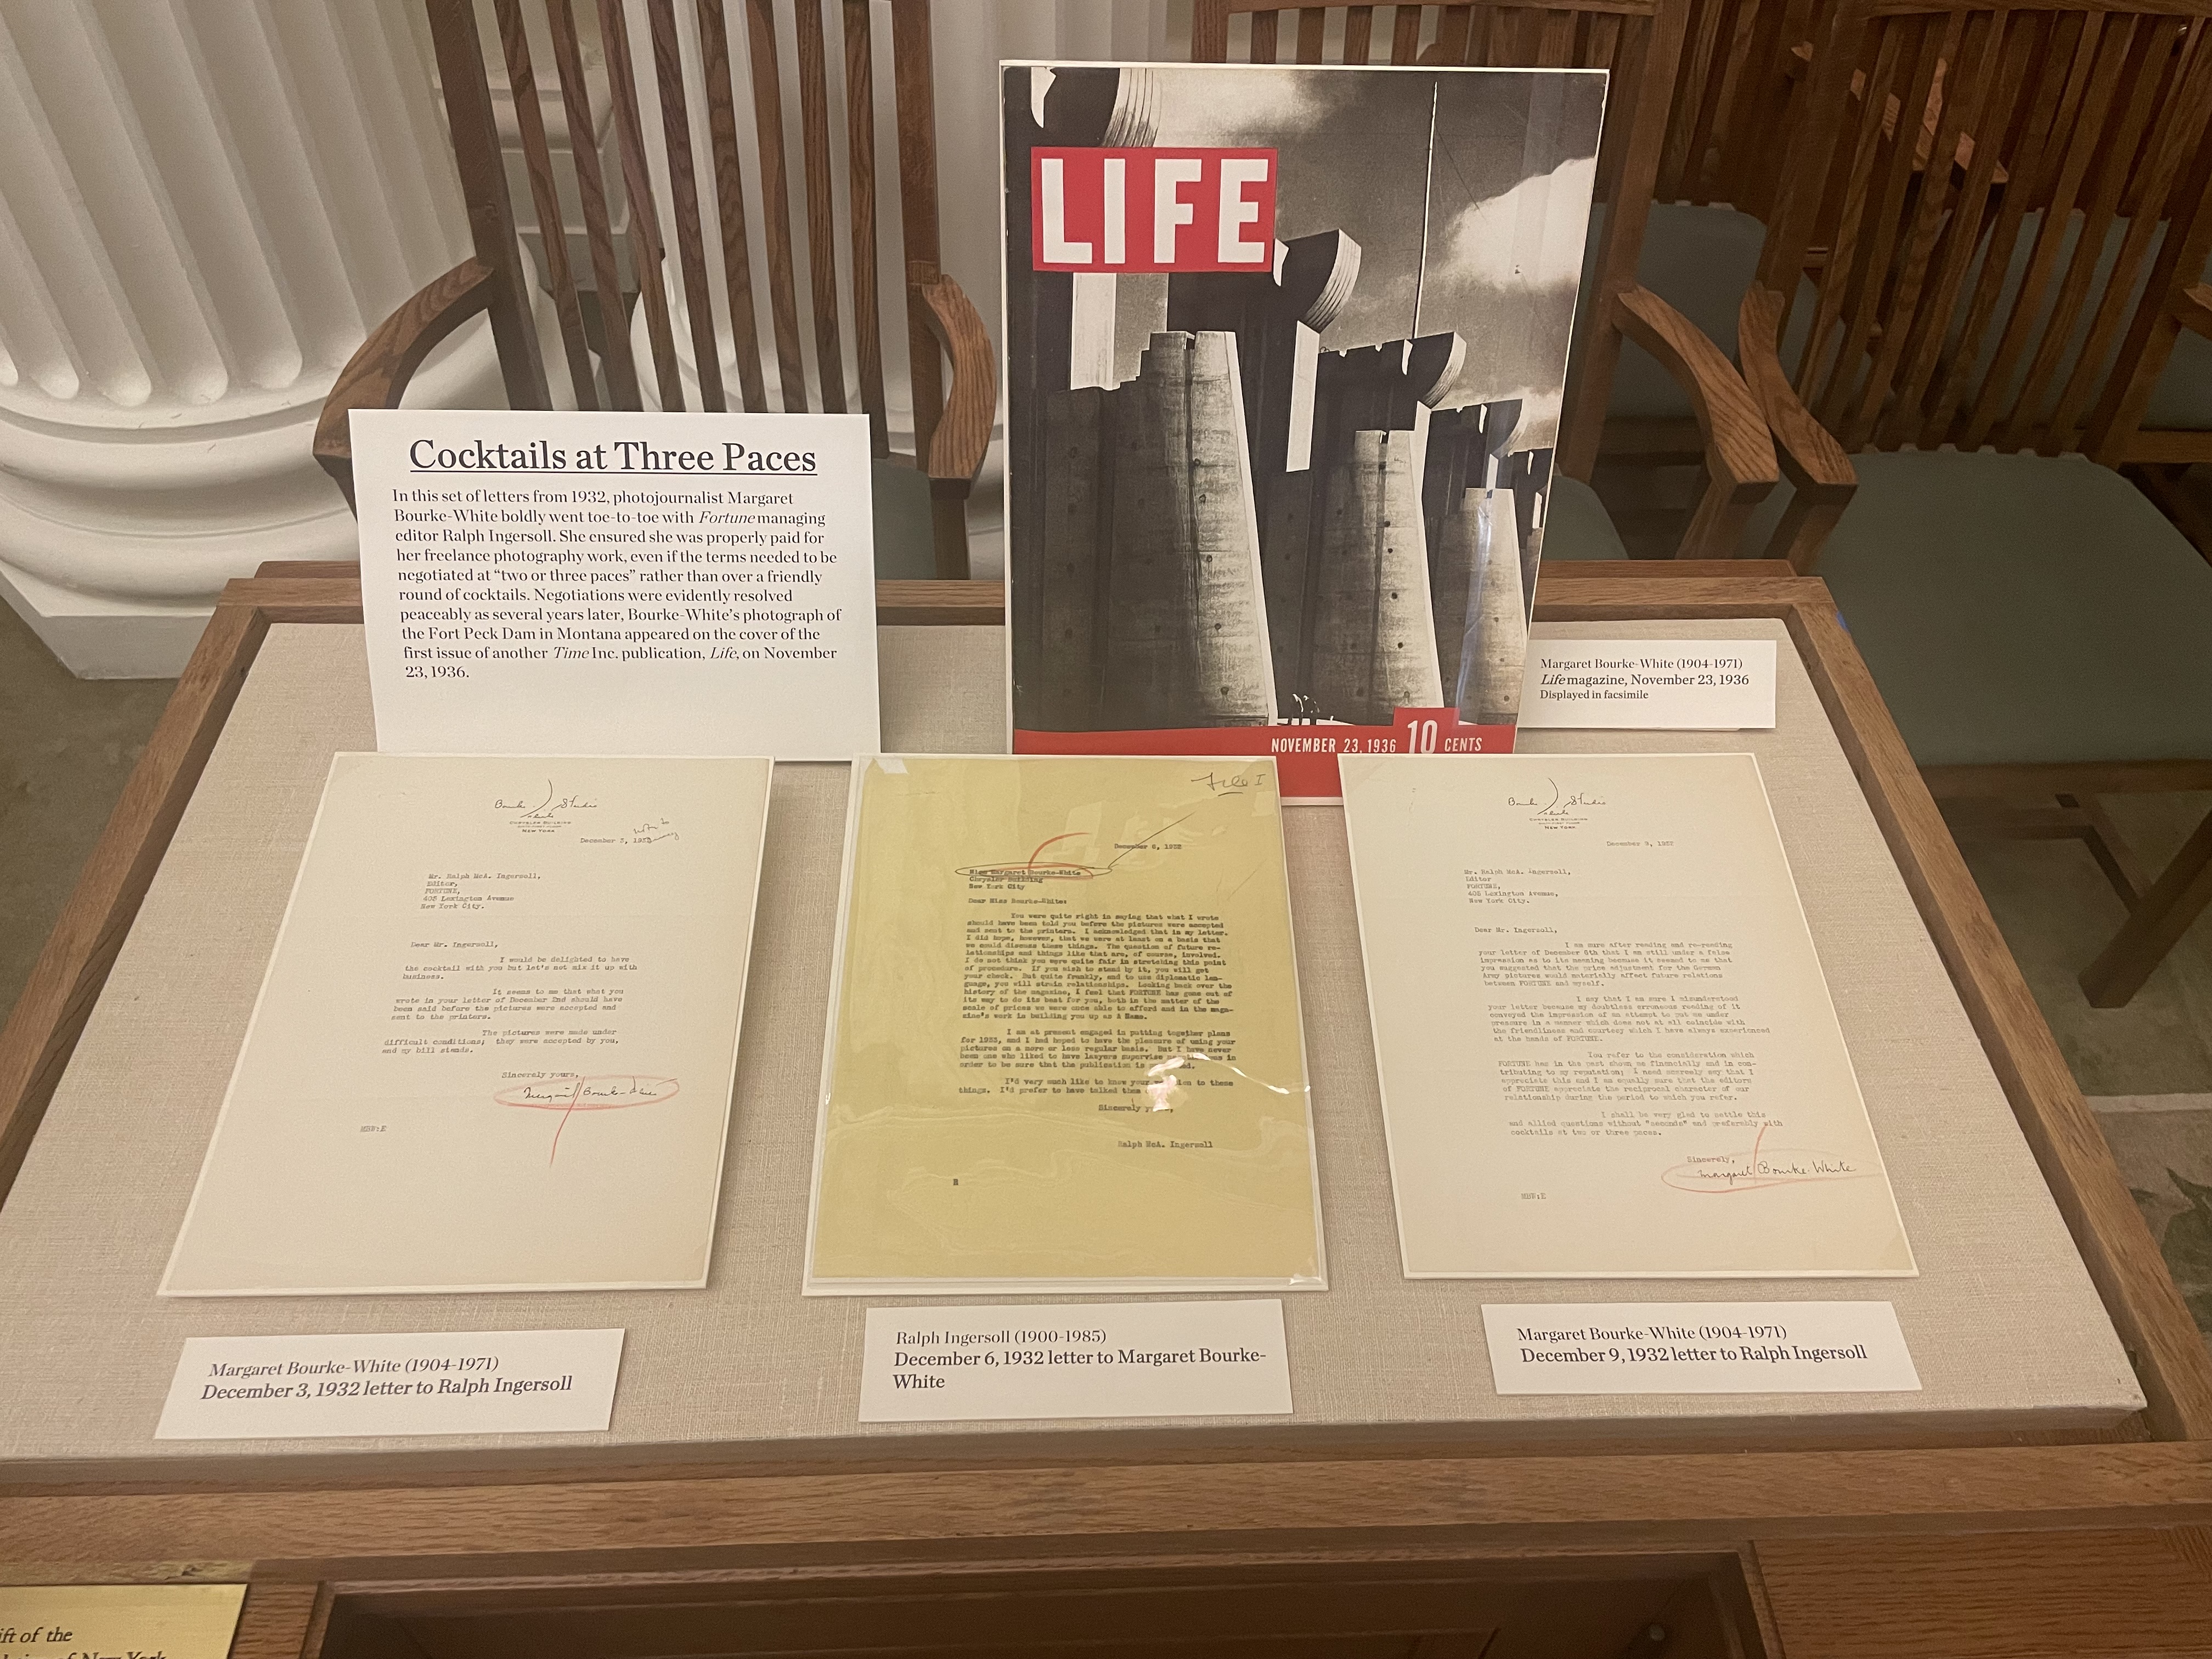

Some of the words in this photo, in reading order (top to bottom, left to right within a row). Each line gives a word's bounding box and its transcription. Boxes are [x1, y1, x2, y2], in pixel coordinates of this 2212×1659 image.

[1041, 159, 1268, 263] LIFE
[410, 440, 566, 469] Cocktails
[577, 445, 607, 469] at
[614, 442, 714, 470] Three
[722, 443, 815, 471] Paces
[393, 489, 408, 501] In
[413, 489, 438, 501] this
[442, 492, 462, 501] set
[466, 489, 481, 501] of
[484, 489, 529, 502] letters
[534, 490, 567, 502] from
[573, 491, 610, 504] 1932,
[613, 490, 723, 506] photojournalist
[728, 492, 792, 507] Margaret
[395, 509, 498, 522] Bourke-White
[501, 510, 545, 525] boldly
[549, 512, 583, 522] went
[589, 512, 658, 523] toe-to-toe
[662, 511, 693, 523] with
[699, 511, 755, 523] Fortune
[758, 512, 825, 527] managing
[396, 529, 438, 541] editor
[443, 529, 484, 544] Ralph
[489, 530, 555, 545] Ingersoll.
[560, 530, 585, 541] She
[590, 531, 645, 542] ensured
[650, 531, 672, 543] she
[707, 531, 766, 546] properly
[771, 532, 799, 546] paid
[805, 532, 824, 543] for
[397, 549, 420, 561] her
[425, 549, 490, 561] freelance
[494, 549, 584, 565] photography
[588, 550, 627, 563] work,
[668, 550, 678, 562] if
[681, 550, 702, 562] the
[707, 552, 746, 562] terms
[751, 551, 799, 562] needed
[804, 553, 817, 563] to
[821, 551, 836, 563] be
[399, 569, 473, 583] negotiated
[478, 571, 490, 580] at
[494, 569, 527, 580] “two
[532, 573, 546, 581] or
[551, 569, 586, 581] three
[591, 569, 635, 584] paces”
[640, 569, 683, 582] rather
[688, 570, 718, 582] than
[722, 574, 753, 582] over
[768, 570, 822, 585] friendly
[399, 588, 441, 600] round
[446, 588, 461, 600] of
[464, 588, 529, 600] cocktails.
[534, 589, 624, 603] Negotiations
[666, 589, 730, 604] evidently
[734, 590, 792, 601] resolved
[401, 608, 471, 623] peaceably
[493, 608, 542, 619] several
[546, 612, 583, 623] years
[588, 608, 623, 622] later,
[629, 608, 739, 620] Bourke-White’s
[744, 609, 823, 623] photograph
[827, 609, 842, 620] of
[404, 646, 432, 658] first
[437, 647, 471, 658] issue
[476, 646, 490, 658] of
[493, 647, 548, 658] another
[554, 647, 589, 658] Time
[592, 647, 618, 658] Inc.
[622, 647, 705, 661] publication,
[710, 647, 739, 659] Life,
[764, 647, 837, 658] November
[1542, 659, 1591, 670] Margaret
[1596, 659, 1673, 668] Bourke-White
[1677, 659, 1742, 670] (1904-1971)
[406, 667, 427, 679] 23,
[432, 667, 469, 678] 1936.
[1541, 674, 1565, 684] Life
[1567, 675, 1627, 687] magazine,
[1631, 674, 1695, 685] November
[1698, 675, 1716, 686] 23,
[1720, 675, 1748, 685] 1936
[1541, 690, 1589, 701] Displayed
[1604, 690, 1648, 698] facsimile
[1408, 720, 1438, 754] 10
[1444, 737, 1482, 752] CENTS
[1272, 738, 1335, 753] NOVEMBER
[1368, 739, 1396, 753] 1936
[897, 1331, 939, 1347] Ralph
[945, 1331, 1009, 1346] Ingersoll
[1015, 1330, 1105, 1344] (1900-1985)
[1517, 1329, 1586, 1343] Margaret
[1589, 1327, 1695, 1339] Bourke-White
[1700, 1325, 1786, 1340] (1904-1971)
[894, 1351, 980, 1366] December
[985, 1351, 998, 1367] 6,
[1004, 1351, 1043, 1364] 1932
[1048, 1350, 1093, 1364] letter
[1097, 1352, 1113, 1363] to
[1118, 1350, 1195, 1366] Margaret
[1199, 1347, 1266, 1362] Bourke-
[1520, 1348, 1605, 1362] December
[1609, 1348, 1624, 1363] 9,
[1627, 1348, 1669, 1361] 1932
[1670, 1347, 1716, 1361] letter
[1720, 1348, 1736, 1360] to
[1739, 1346, 1791, 1363] Ralph
[1791, 1345, 1867, 1363] Ingersoll
[208, 1363, 282, 1379] Margaret
[286, 1359, 400, 1374] Bourke-White
[405, 1357, 498, 1373] (1904-1971)
[200, 1384, 294, 1399] December
[296, 1383, 311, 1398] 3,
[315, 1382, 360, 1396] 1932
[363, 1380, 413, 1395] letter
[417, 1381, 433, 1394] to
[437, 1378, 489, 1396] Ralph
[493, 1375, 572, 1395] Ingersoll
[893, 1374, 945, 1389] White
[0, 1628, 16, 1643] ift
[20, 1627, 44, 1643] of
[47, 1627, 72, 1642] the
